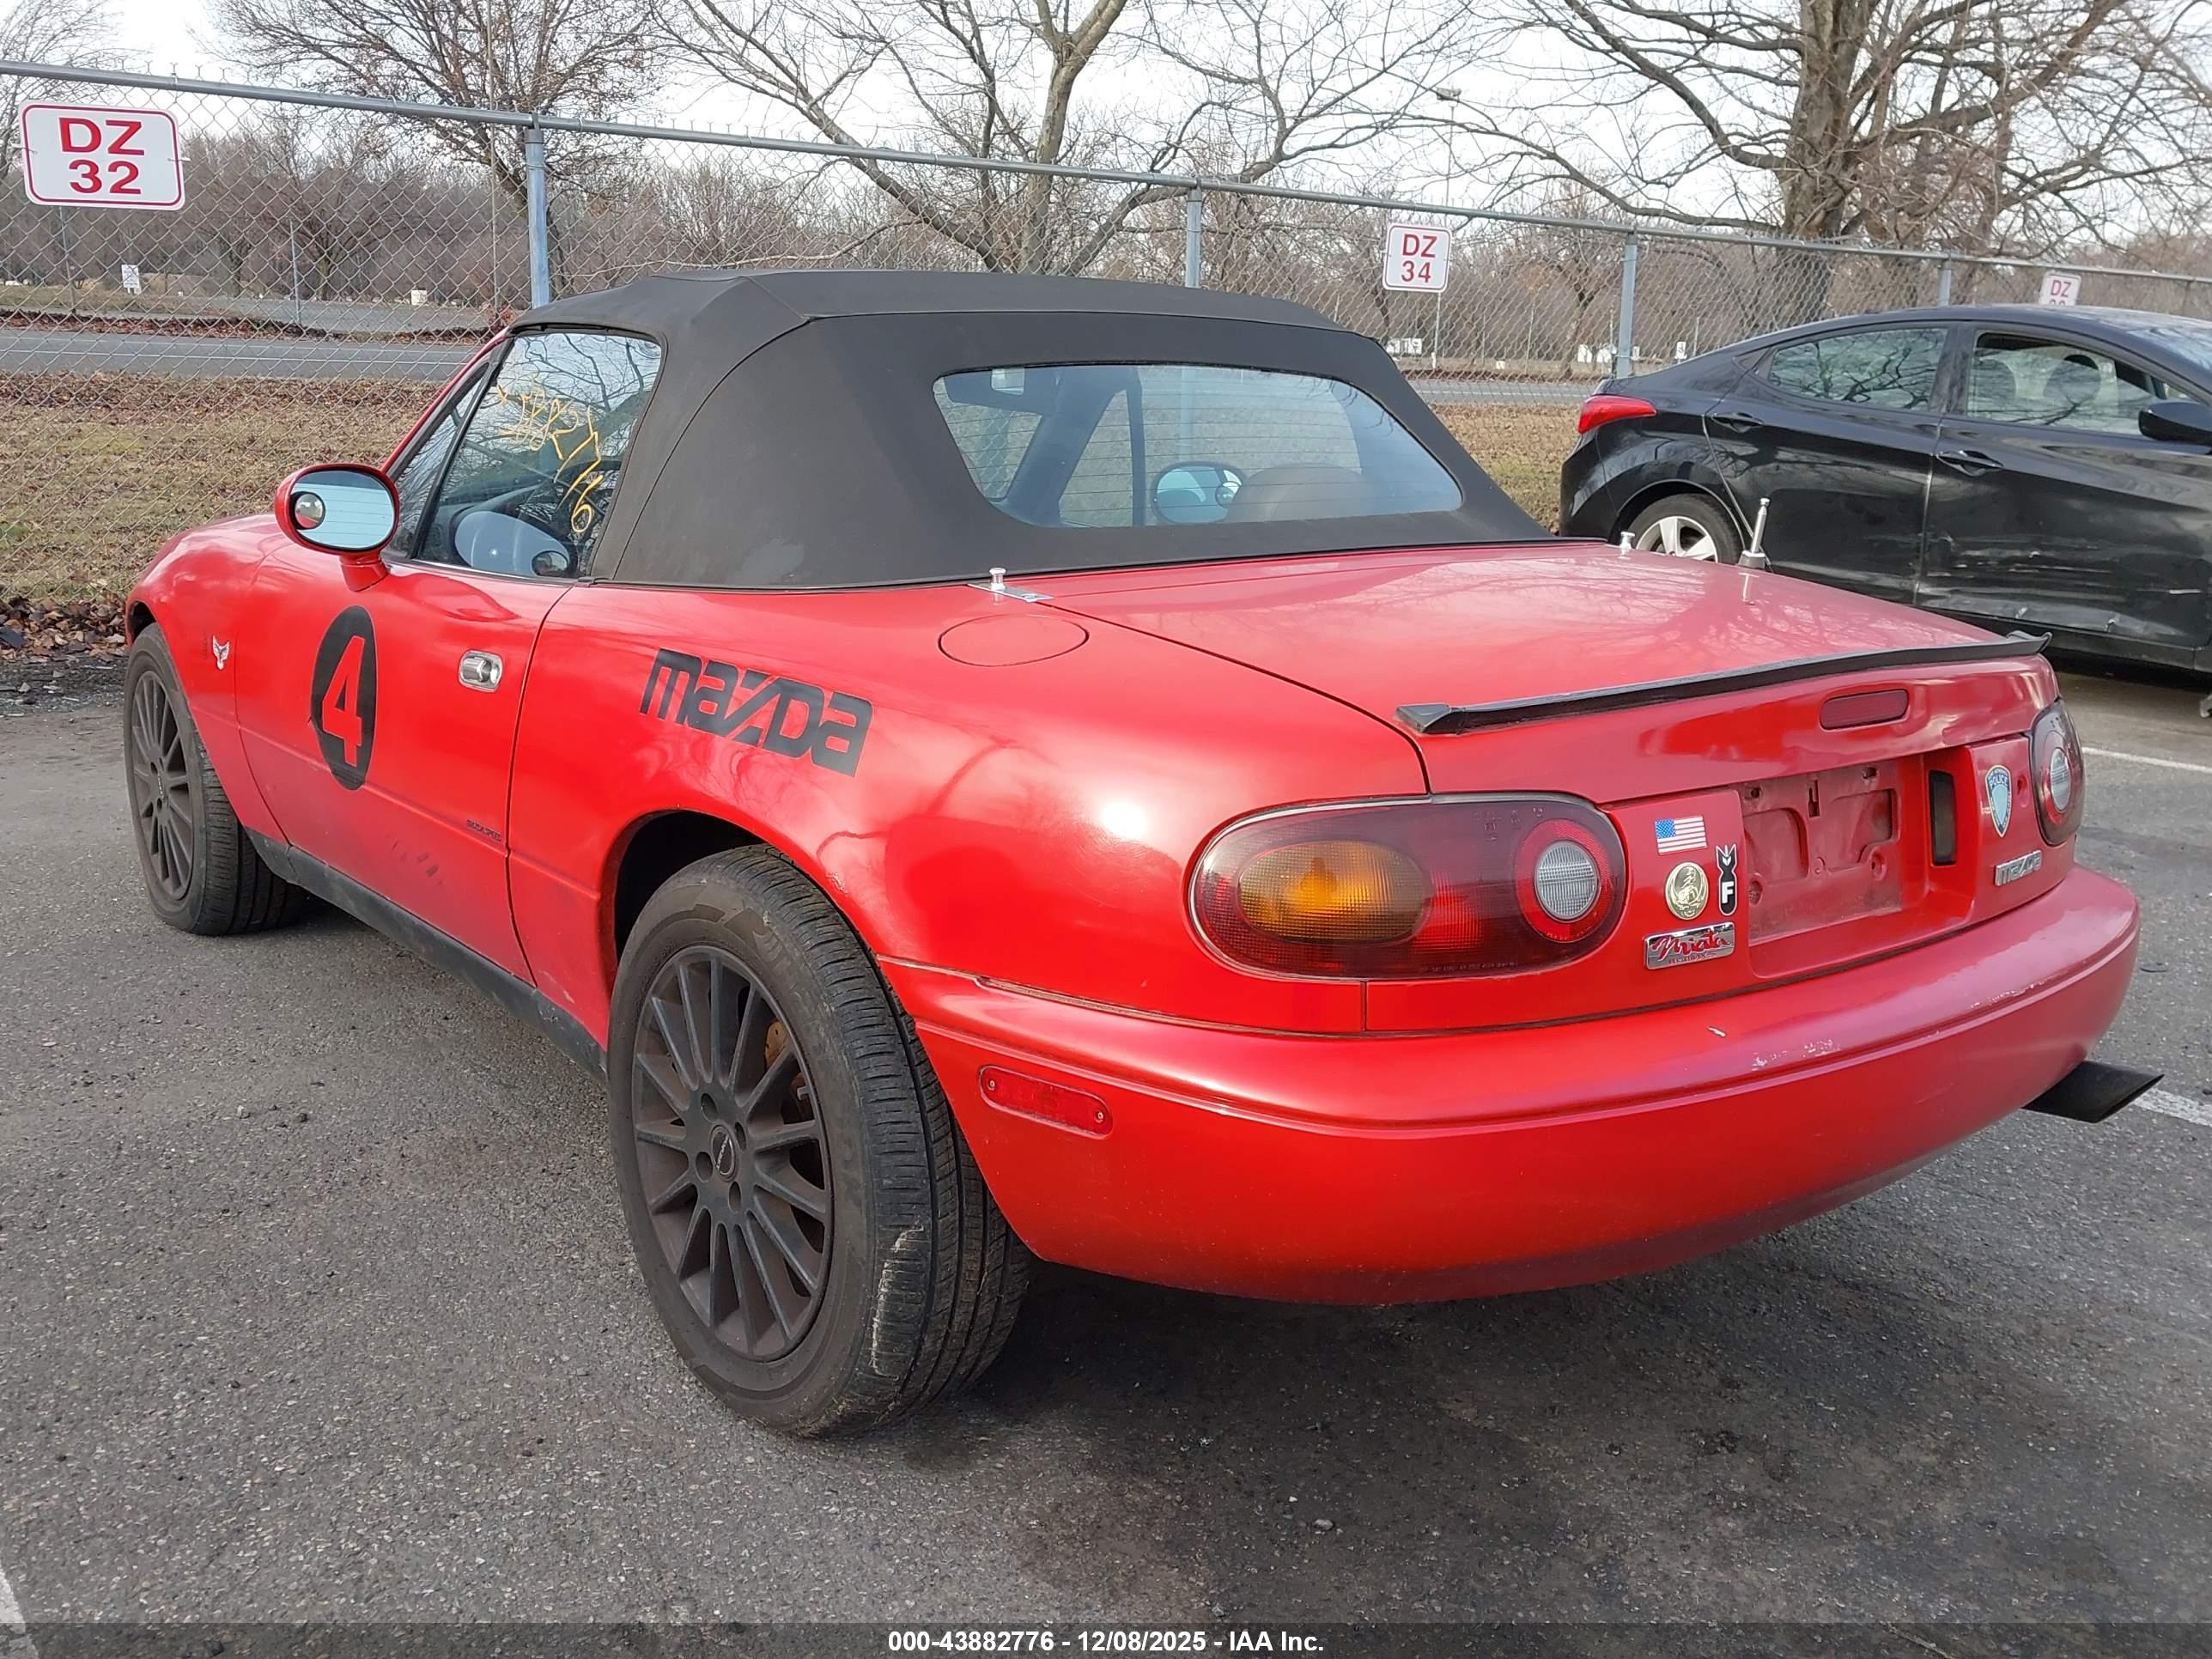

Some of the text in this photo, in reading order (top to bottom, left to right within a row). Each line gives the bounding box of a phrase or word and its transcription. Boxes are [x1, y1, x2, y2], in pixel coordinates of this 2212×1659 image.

[58, 117, 145, 156] DZ
[69, 159, 142, 195] 32
[1402, 233, 1438, 258] DZ
[1401, 260, 1431, 283] 34
[2051, 279, 2072, 298] DZ
[322, 635, 365, 767] 4
[1988, 774, 2009, 788] POLICE
[1722, 881, 1734, 904] F
[1651, 928, 1731, 961] Miata
